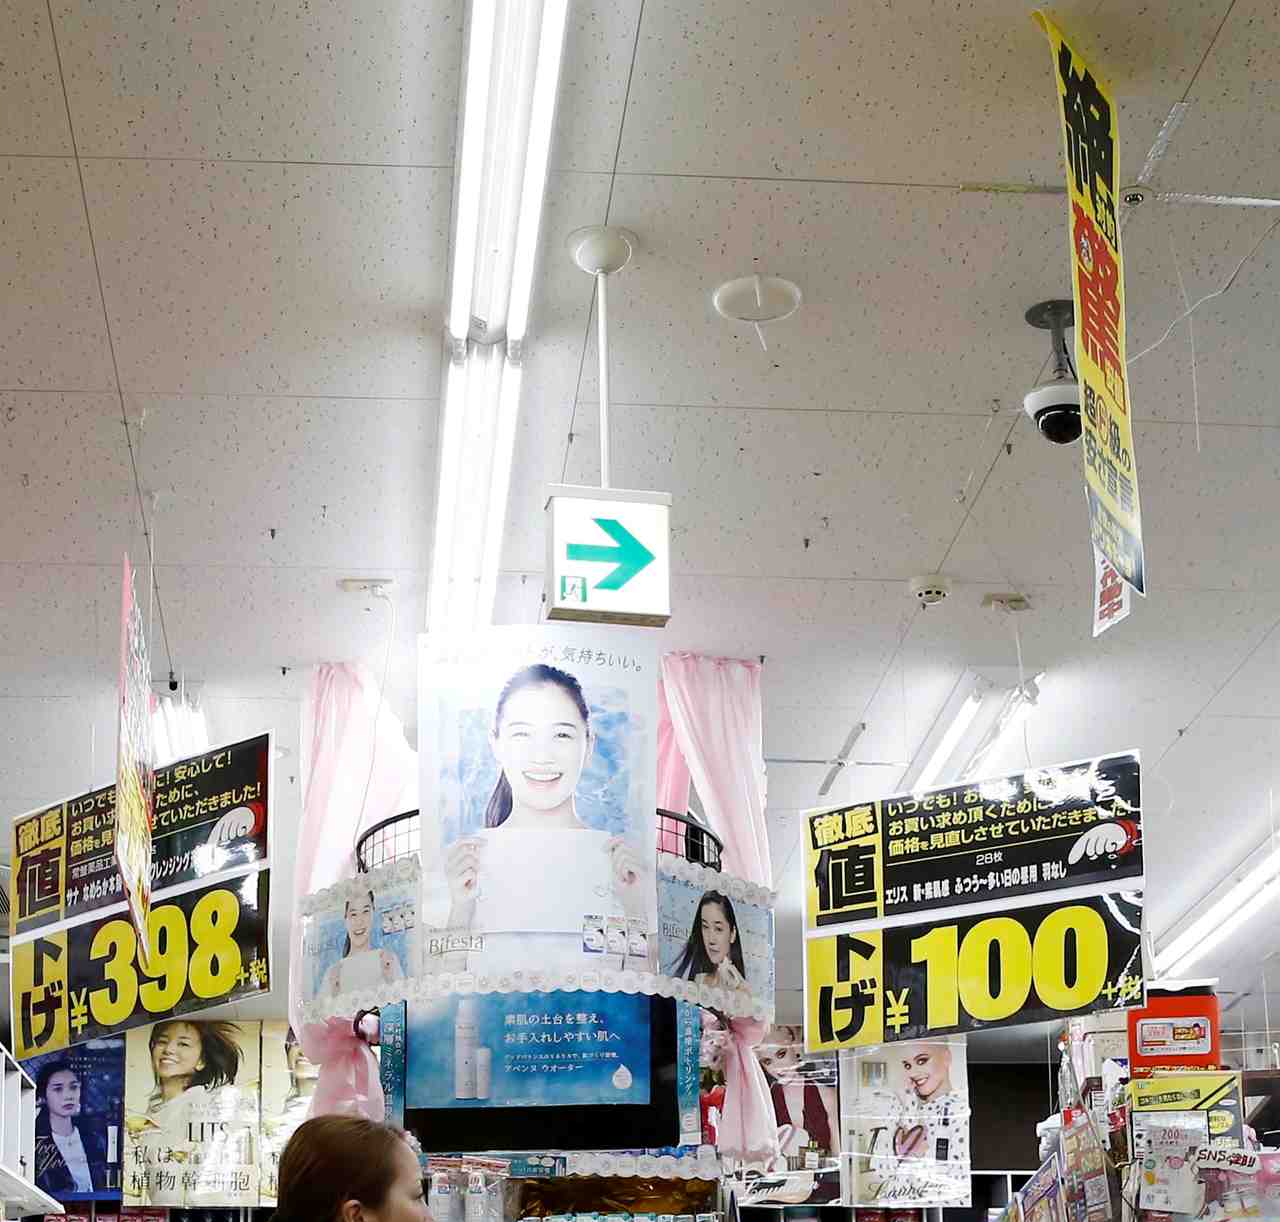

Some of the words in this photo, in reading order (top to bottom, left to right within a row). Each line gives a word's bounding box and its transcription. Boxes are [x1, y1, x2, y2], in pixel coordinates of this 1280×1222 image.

[17, 811, 64, 852] 徹底
[812, 806, 874, 848] 徹底
[975, 852, 1004, 866] 28枚
[885, 886, 909, 906] エリス
[1042, 860, 1067, 882] 羽なし
[428, 933, 485, 956] Bifesta
[70, 988, 88, 1034] ¥
[88, 890, 242, 1027] 398
[238, 957, 267, 986] +税
[886, 987, 910, 1034] ¥
[910, 905, 1109, 1032] 100
[504, 1013, 605, 1026] 素肌の土台を整え、
[503, 1030, 621, 1045] お手入れしやすい肌へ
[186, 1121, 230, 1143] LITS
